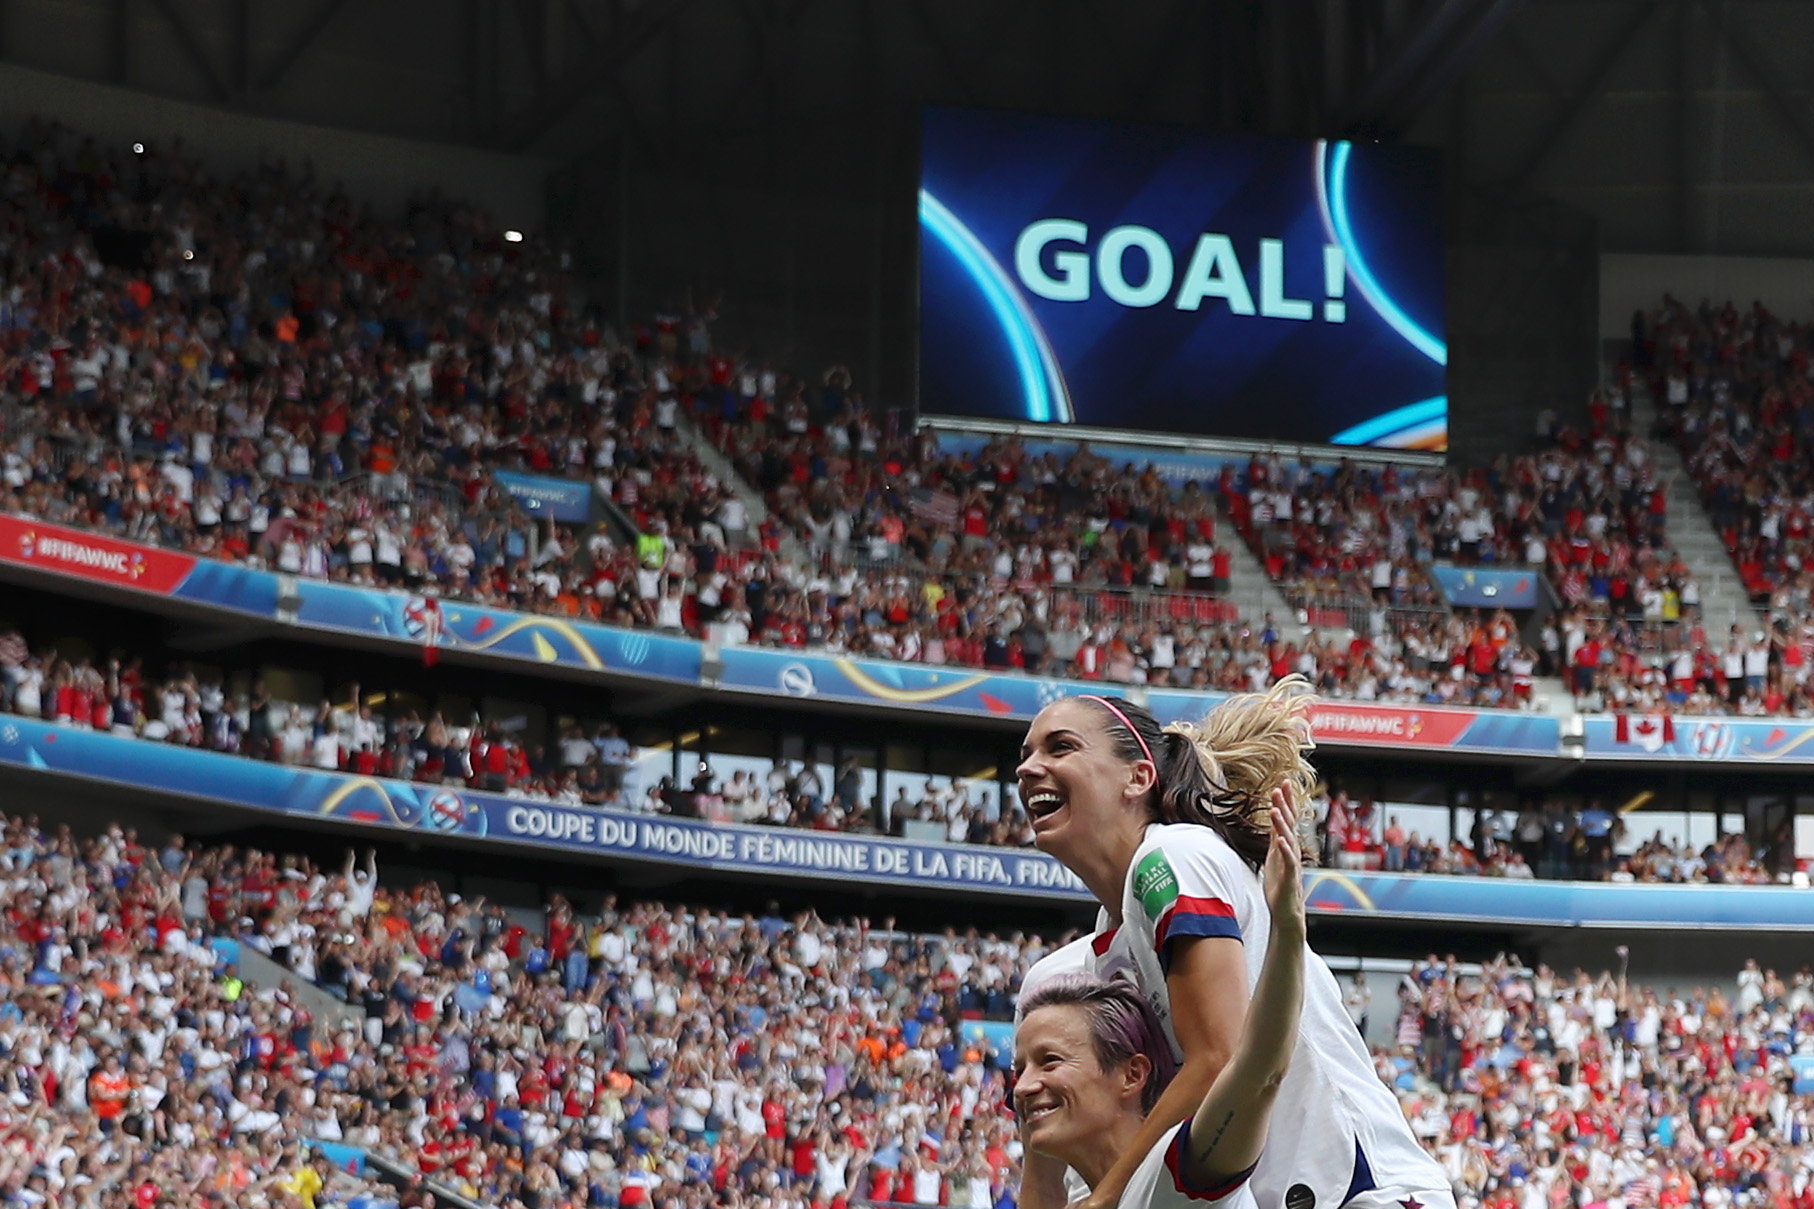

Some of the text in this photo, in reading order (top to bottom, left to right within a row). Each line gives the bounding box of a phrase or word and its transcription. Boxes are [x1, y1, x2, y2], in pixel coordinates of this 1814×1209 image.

[1014, 217, 1346, 323] GOAL!
[38, 536, 129, 574] #FIFAWWC
[1311, 712, 1403, 735] #FIFAWWC
[507, 806, 595, 843] COUPE
[601, 818, 637, 847] DU
[644, 824, 736, 859] MONDE
[743, 834, 870, 872] FÉMININE
[873, 847, 910, 875] DE
[913, 850, 950, 878] LA
[954, 853, 1013, 886] FIFA,
